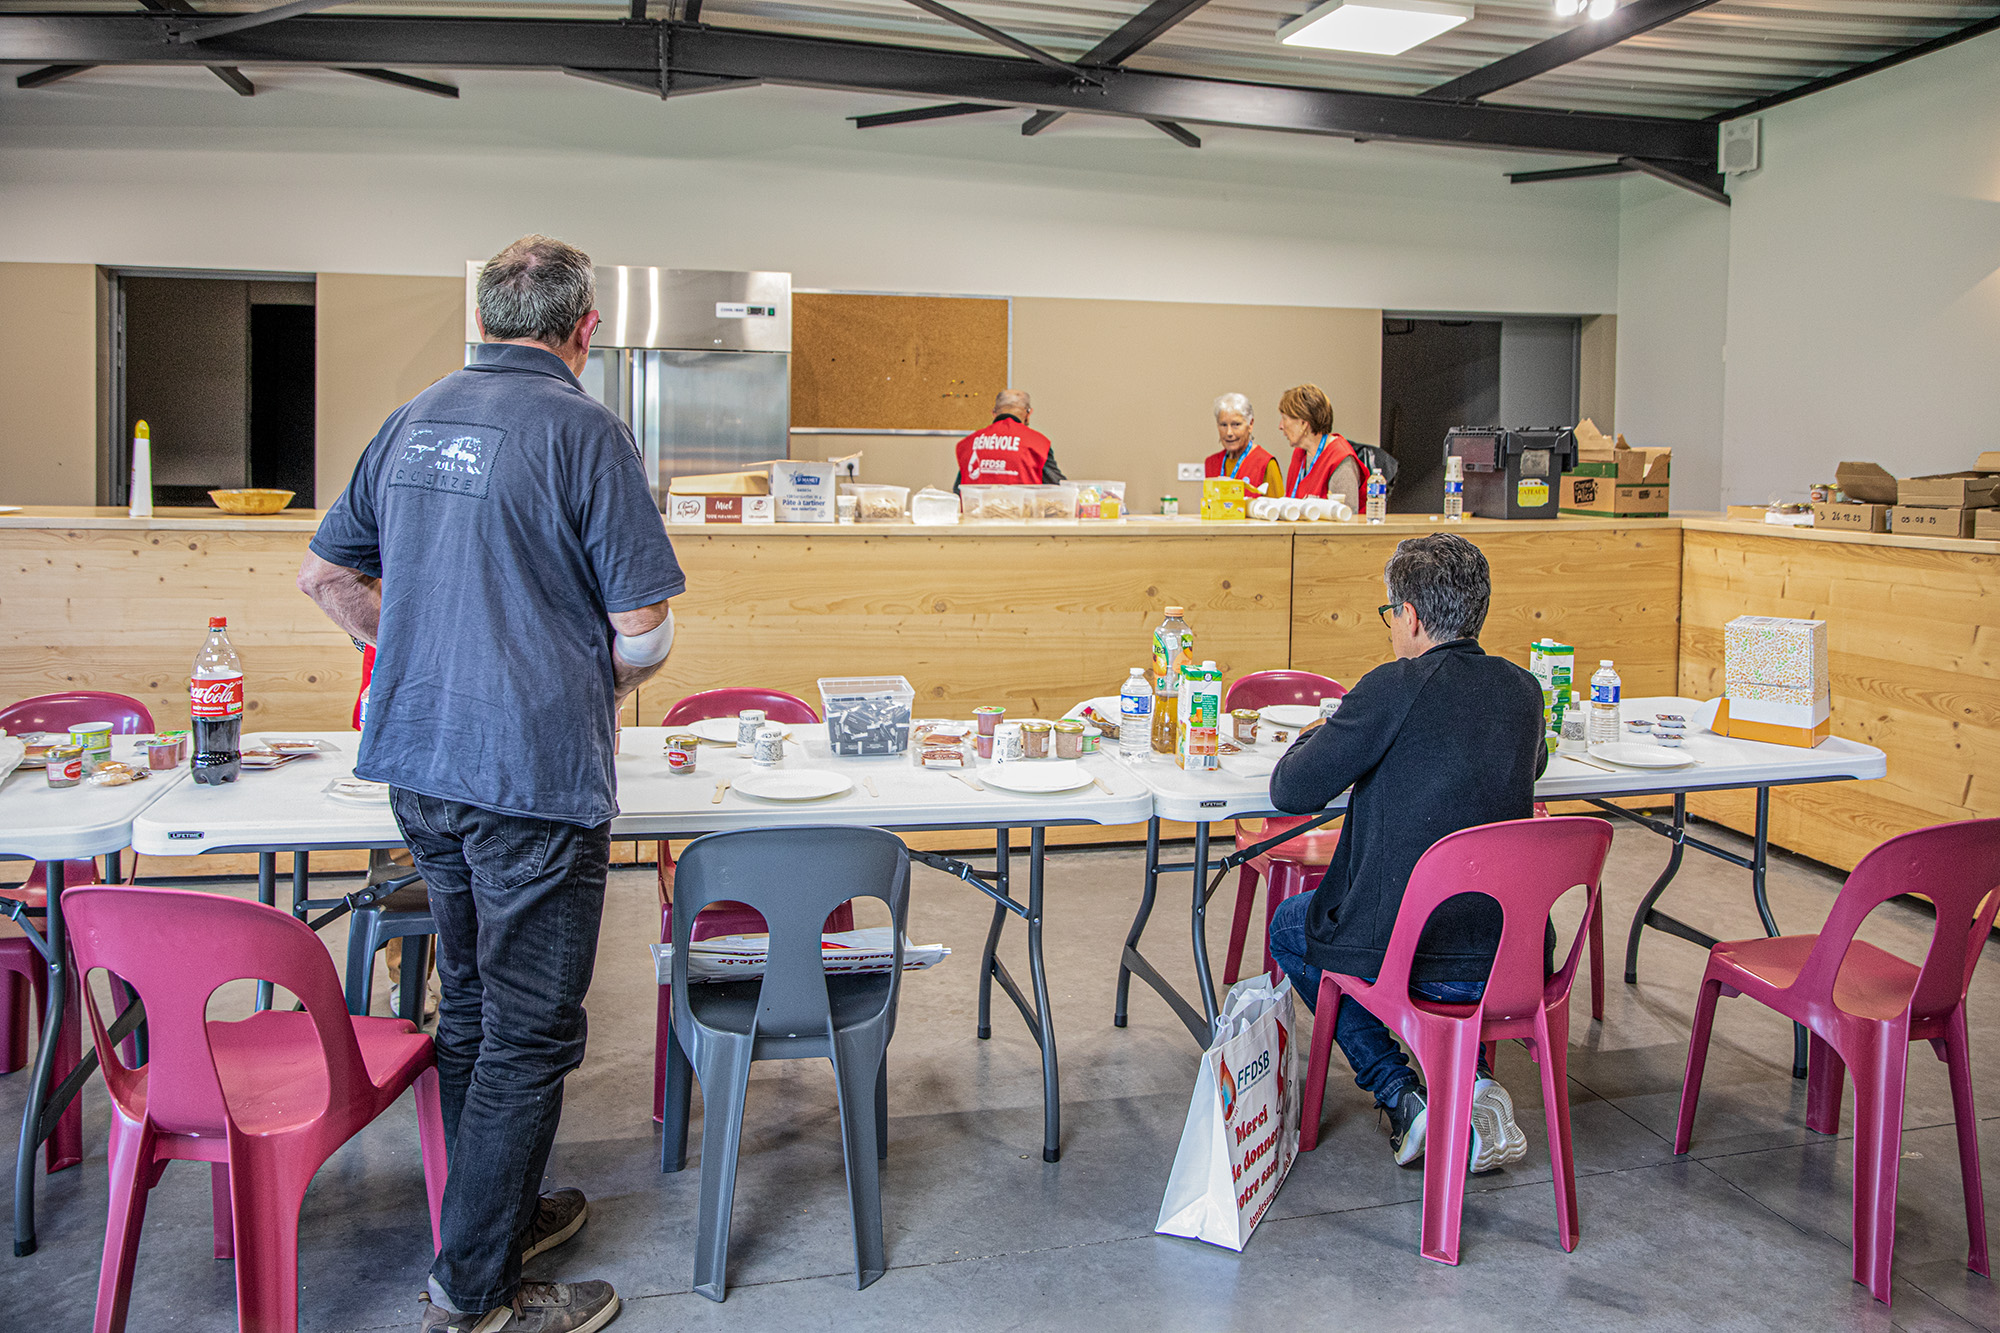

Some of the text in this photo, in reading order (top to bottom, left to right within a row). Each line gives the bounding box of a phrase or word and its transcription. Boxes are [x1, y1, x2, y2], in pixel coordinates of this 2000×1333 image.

[972, 433, 1021, 451] BÉNÉVOLE
[980, 459, 1006, 469] FFDSB
[715, 500, 733, 510] Miel
[1153, 644, 1166, 654] tea
[1237, 1050, 1270, 1090] FFDSB
[1235, 1103, 1269, 1147] Merci
[1237, 1178, 1260, 1211] otre
